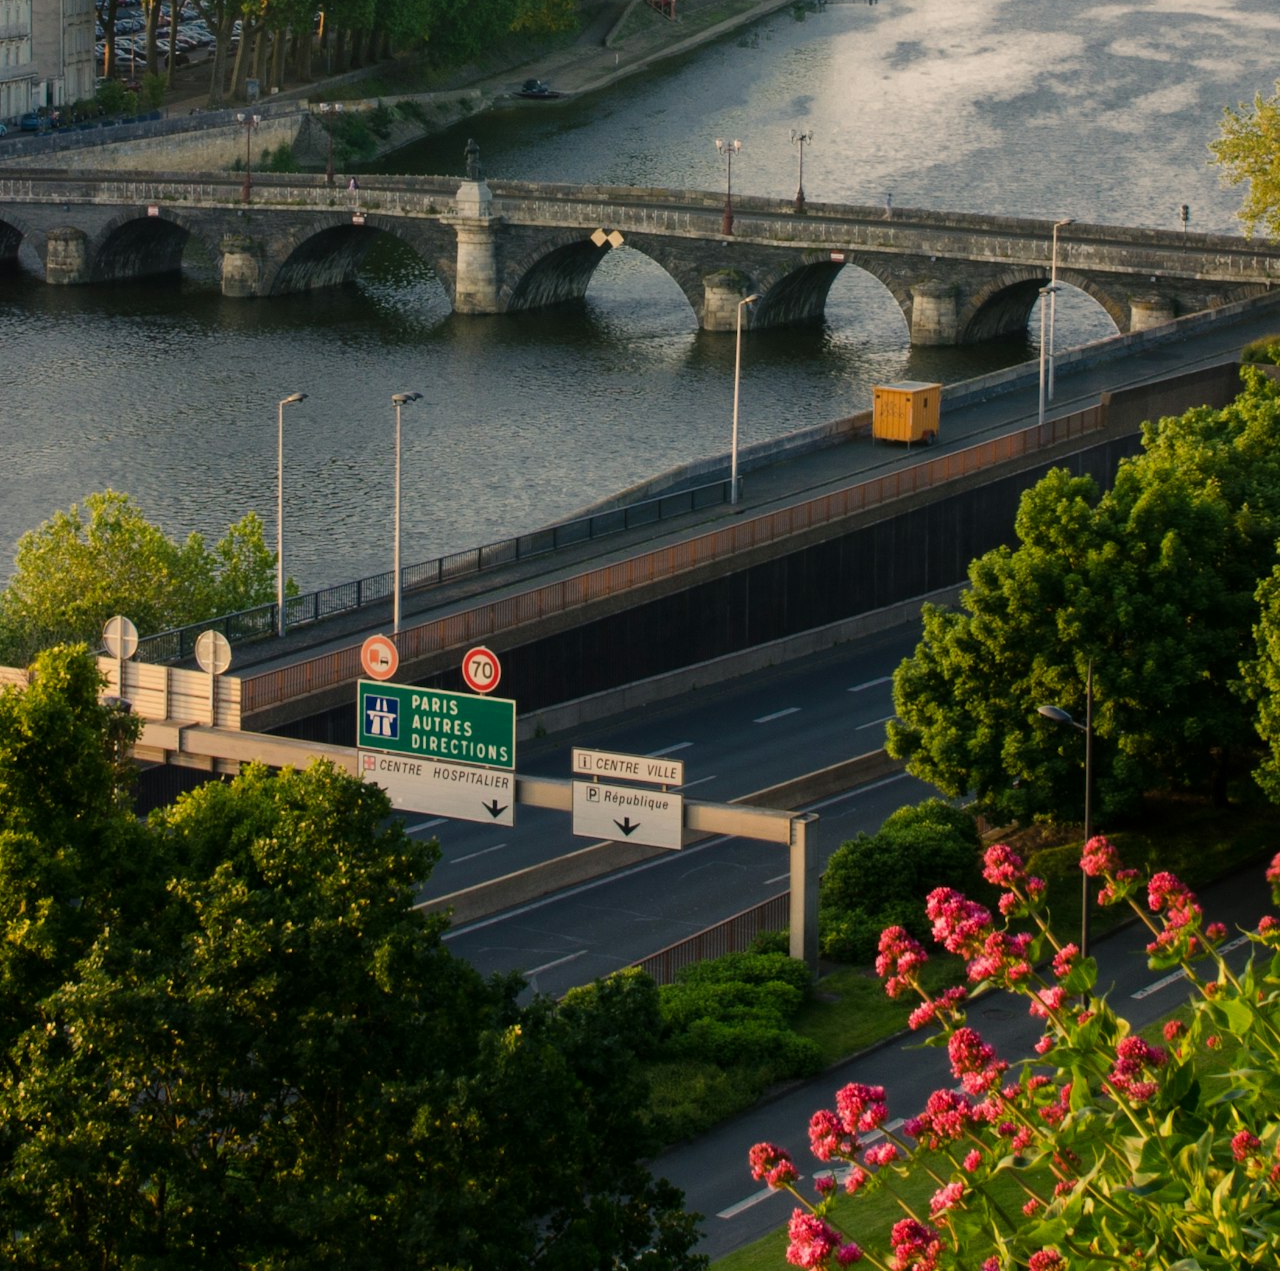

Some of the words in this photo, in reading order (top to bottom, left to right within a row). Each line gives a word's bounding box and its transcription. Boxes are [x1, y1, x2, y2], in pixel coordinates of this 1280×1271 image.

[471, 660, 493, 679] 70
[411, 694, 458, 715] PARIS
[411, 714, 472, 737] AUTRES
[411, 733, 508, 762] DIRECTIONS
[379, 759, 422, 776] CENTRE
[433, 767, 509, 789] HOSPITALIER
[596, 758, 640, 775] CENTRE
[647, 763, 677, 779] VILLE
[604, 790, 669, 810] République
